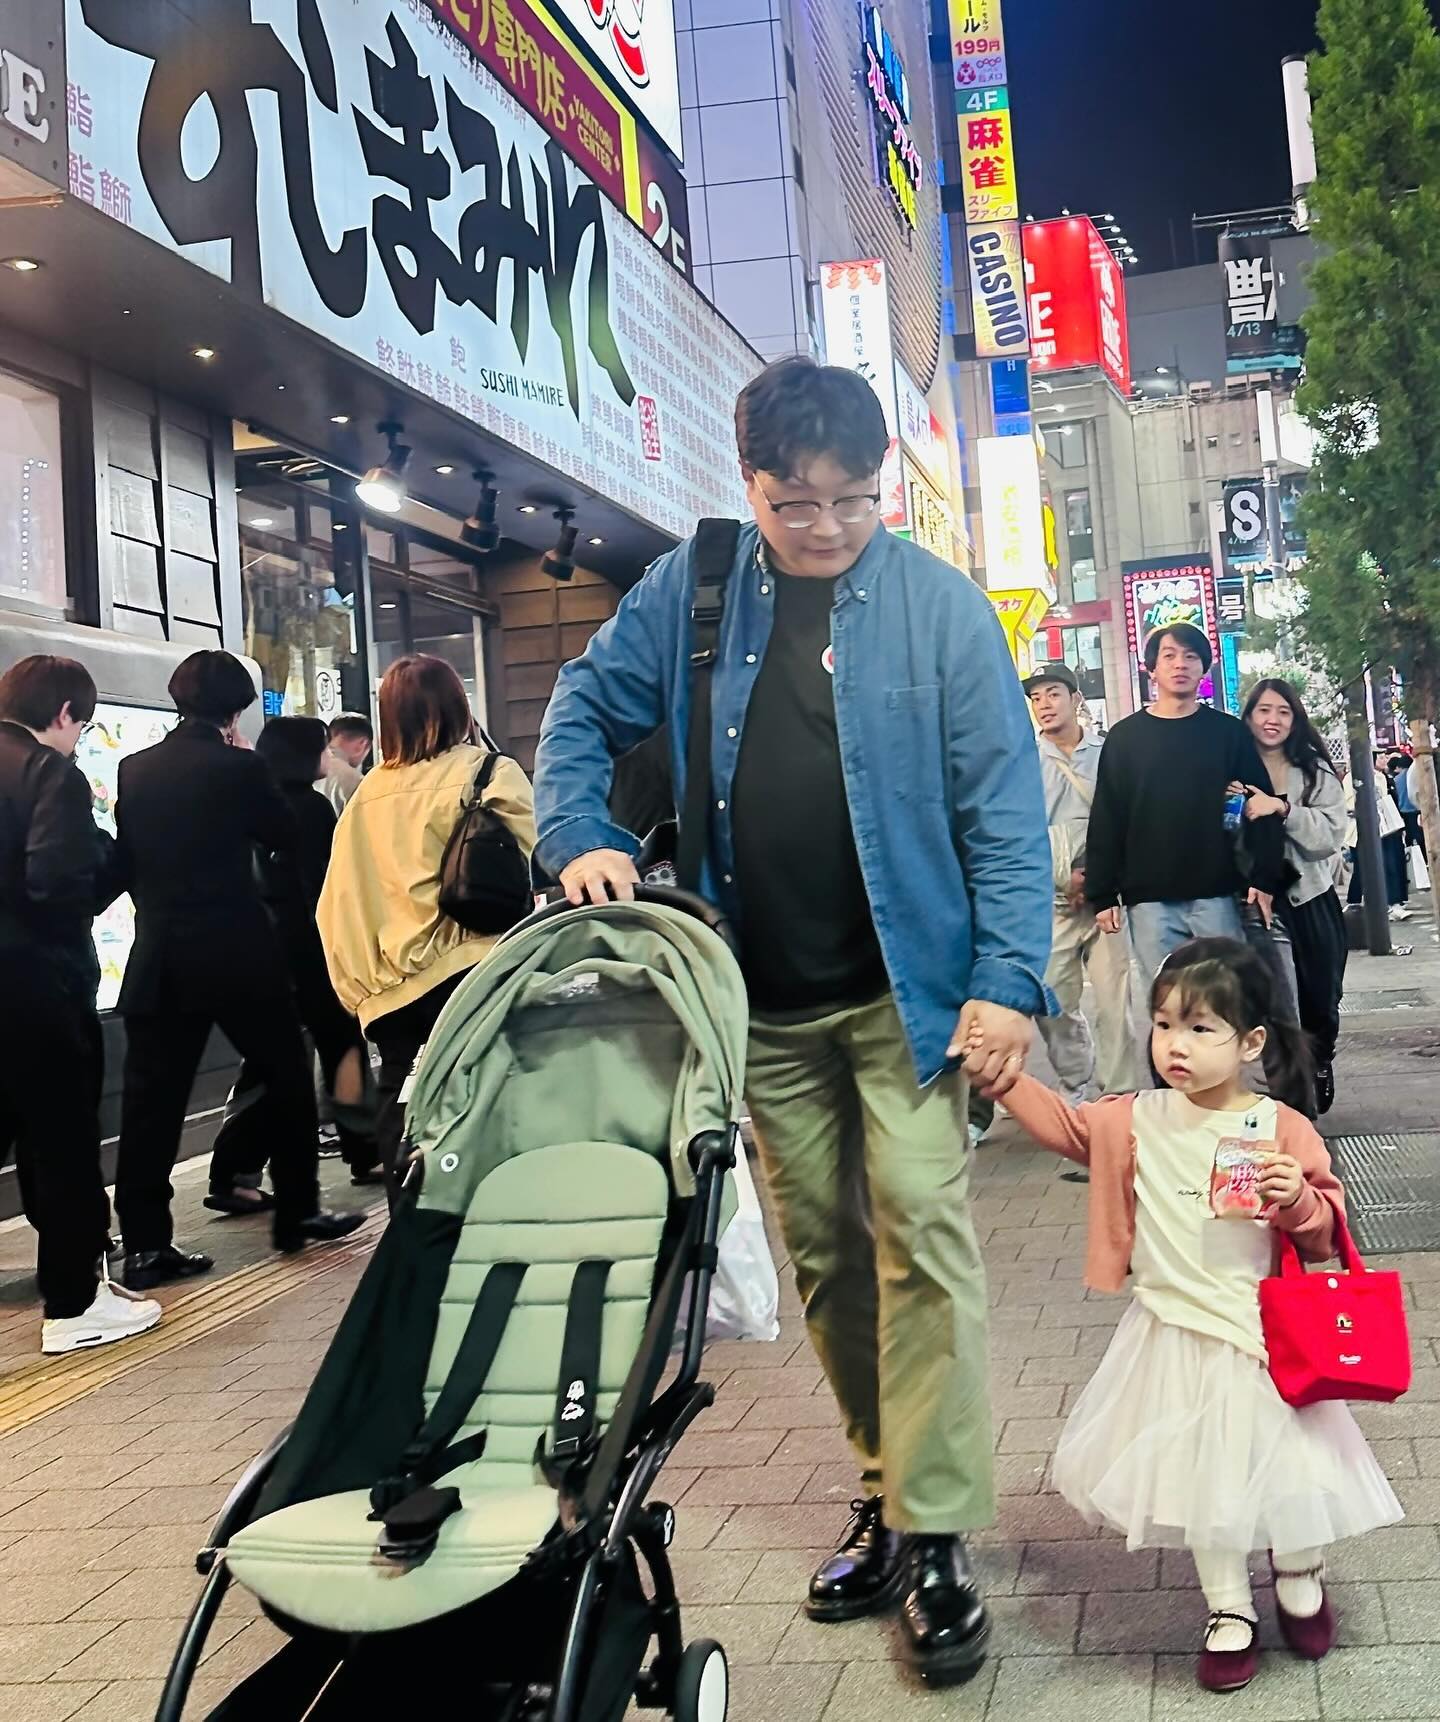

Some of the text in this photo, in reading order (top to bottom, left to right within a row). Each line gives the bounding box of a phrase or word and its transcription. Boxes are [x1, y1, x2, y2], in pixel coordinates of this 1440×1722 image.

[955, 38, 1000, 55] 199円
[966, 90, 998, 111] 4F
[967, 117, 1008, 190] 麻雀
[969, 231, 1026, 347] CASINO
[1226, 322, 1261, 337] 4/13
[480, 368, 564, 407] SUSHI MAMIRE
